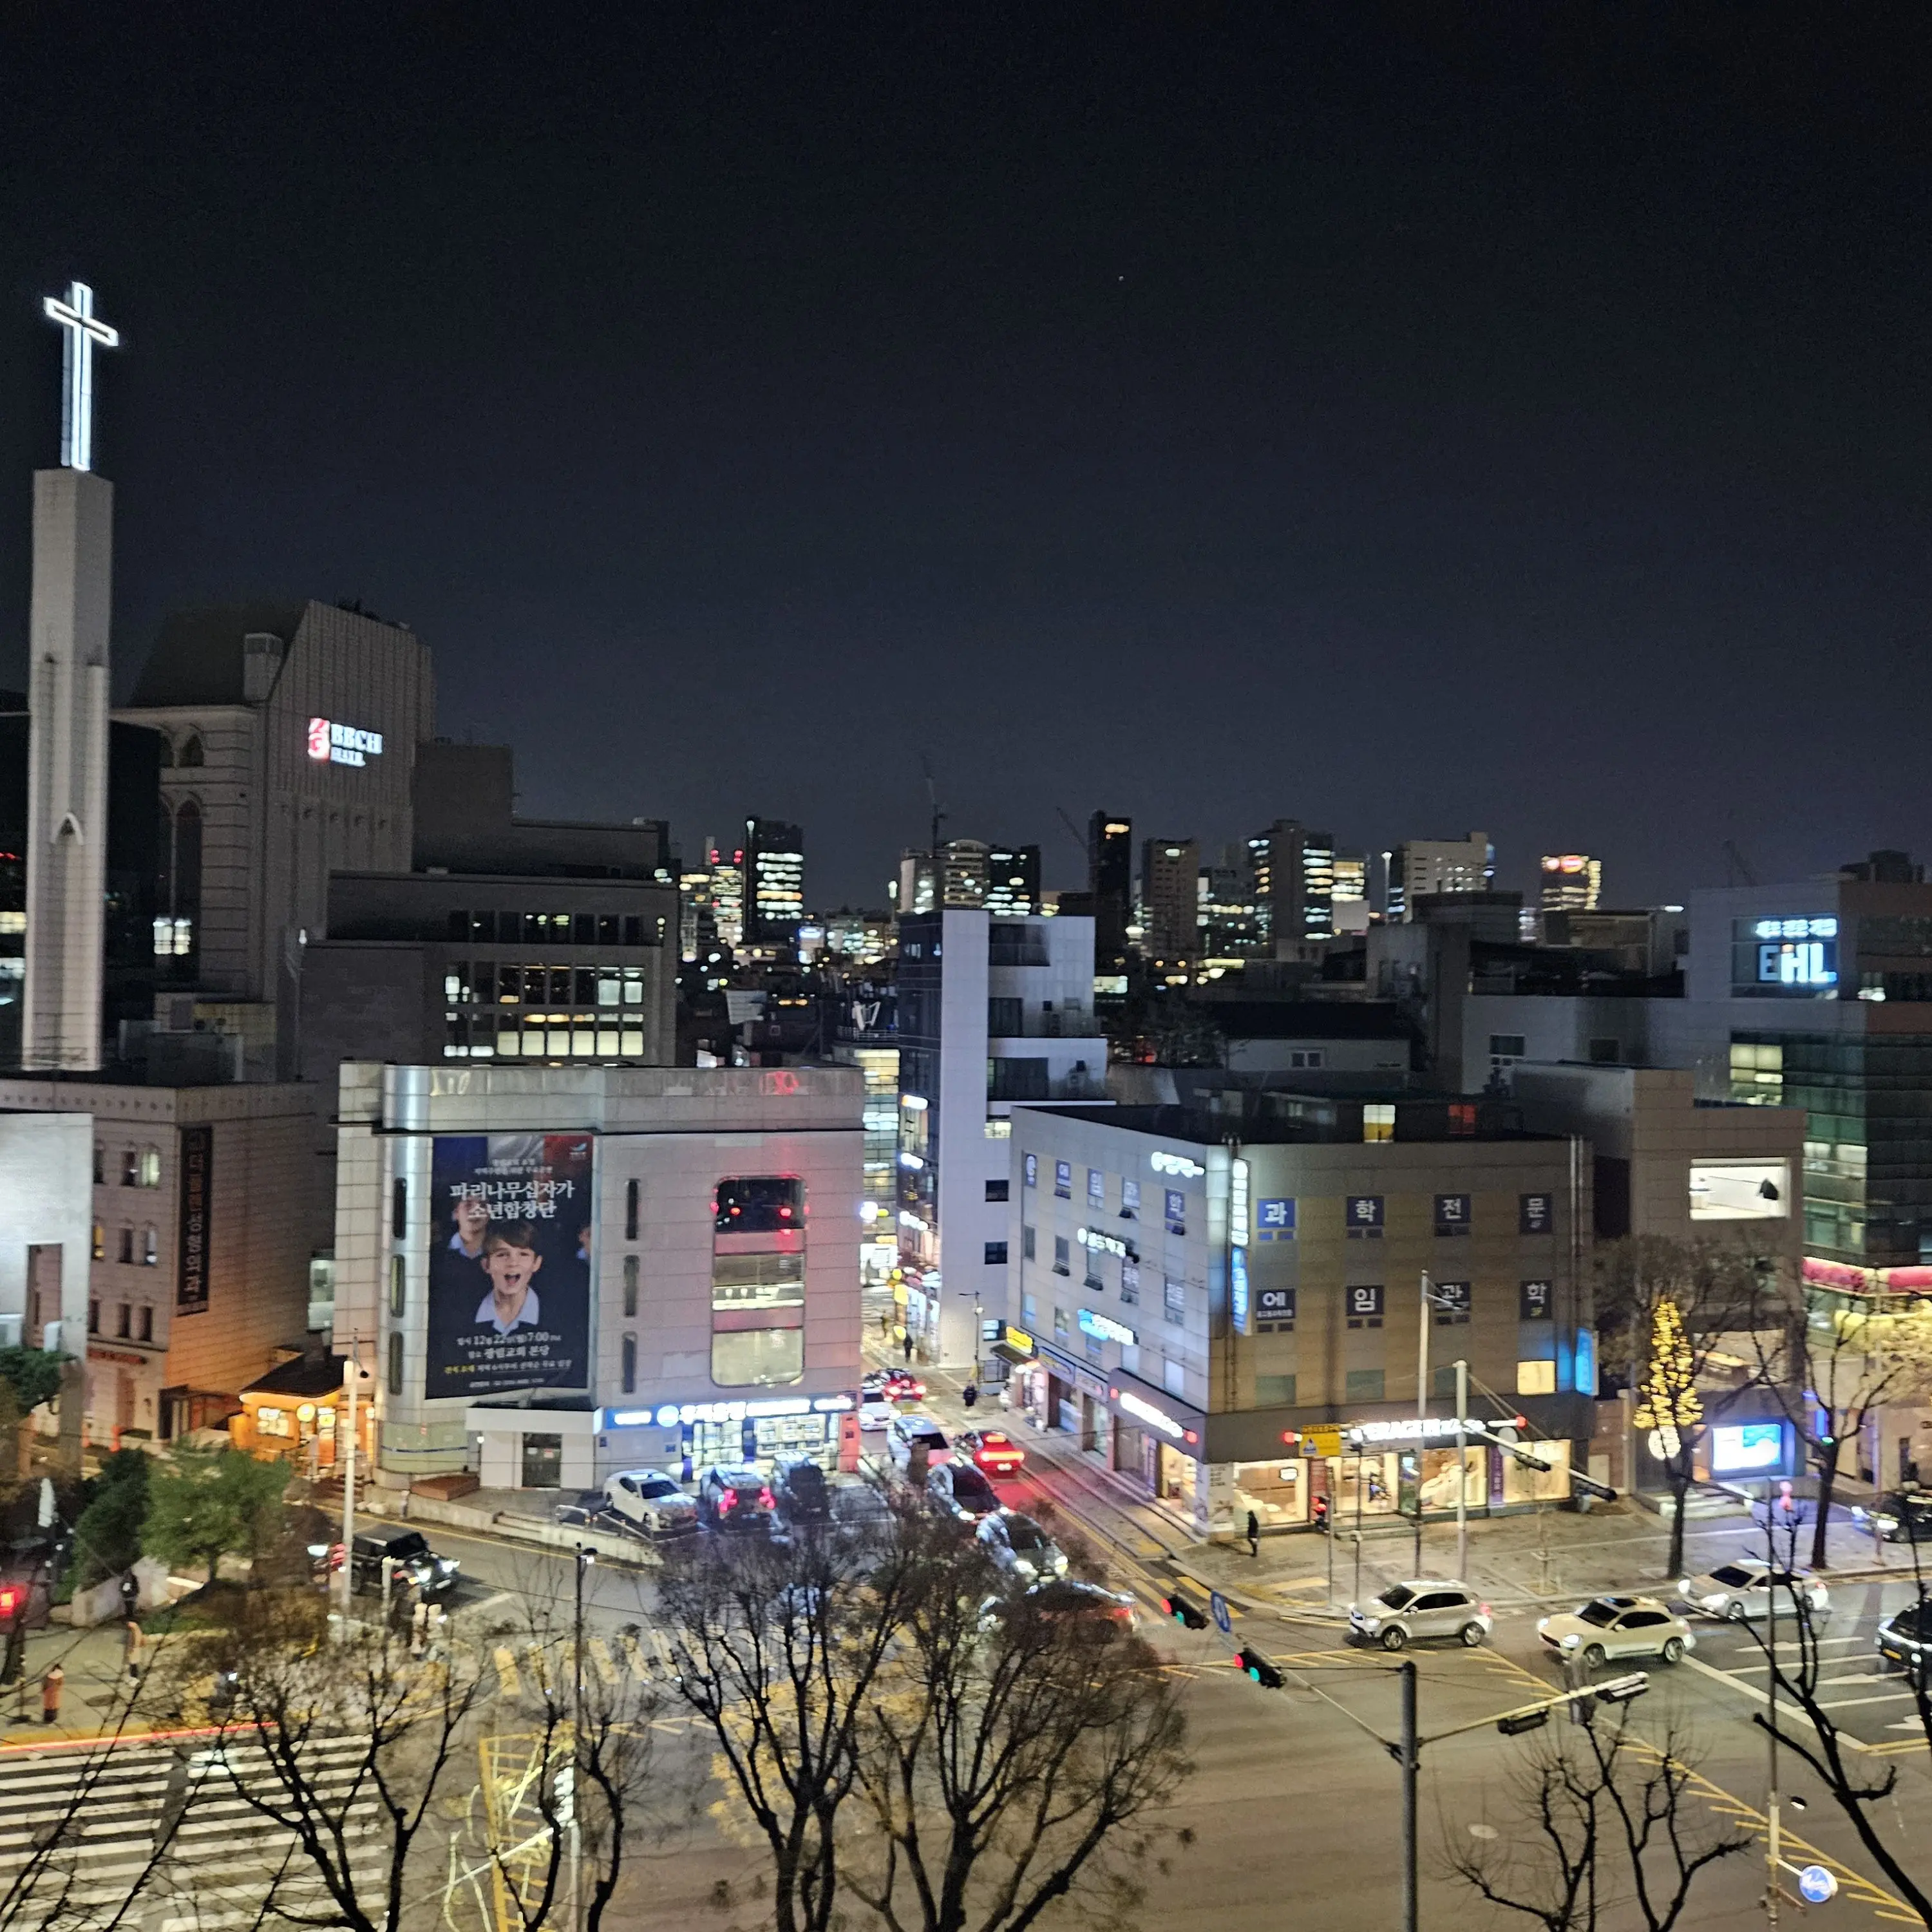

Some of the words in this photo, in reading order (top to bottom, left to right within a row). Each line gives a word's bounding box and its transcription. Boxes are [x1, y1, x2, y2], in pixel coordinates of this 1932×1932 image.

[330, 724, 383, 754] BBCH
[450, 1180, 575, 1200] 파리나무십자가
[468, 1200, 557, 1220] 소년합창단
[1264, 1202, 1287, 1225] 과
[1355, 1200, 1376, 1222] 학
[1443, 1198, 1462, 1220] 전
[1526, 1197, 1546, 1218] 문
[1263, 1291, 1286, 1306] 에
[1354, 1288, 1376, 1312] 임
[1526, 1283, 1547, 1305] 학
